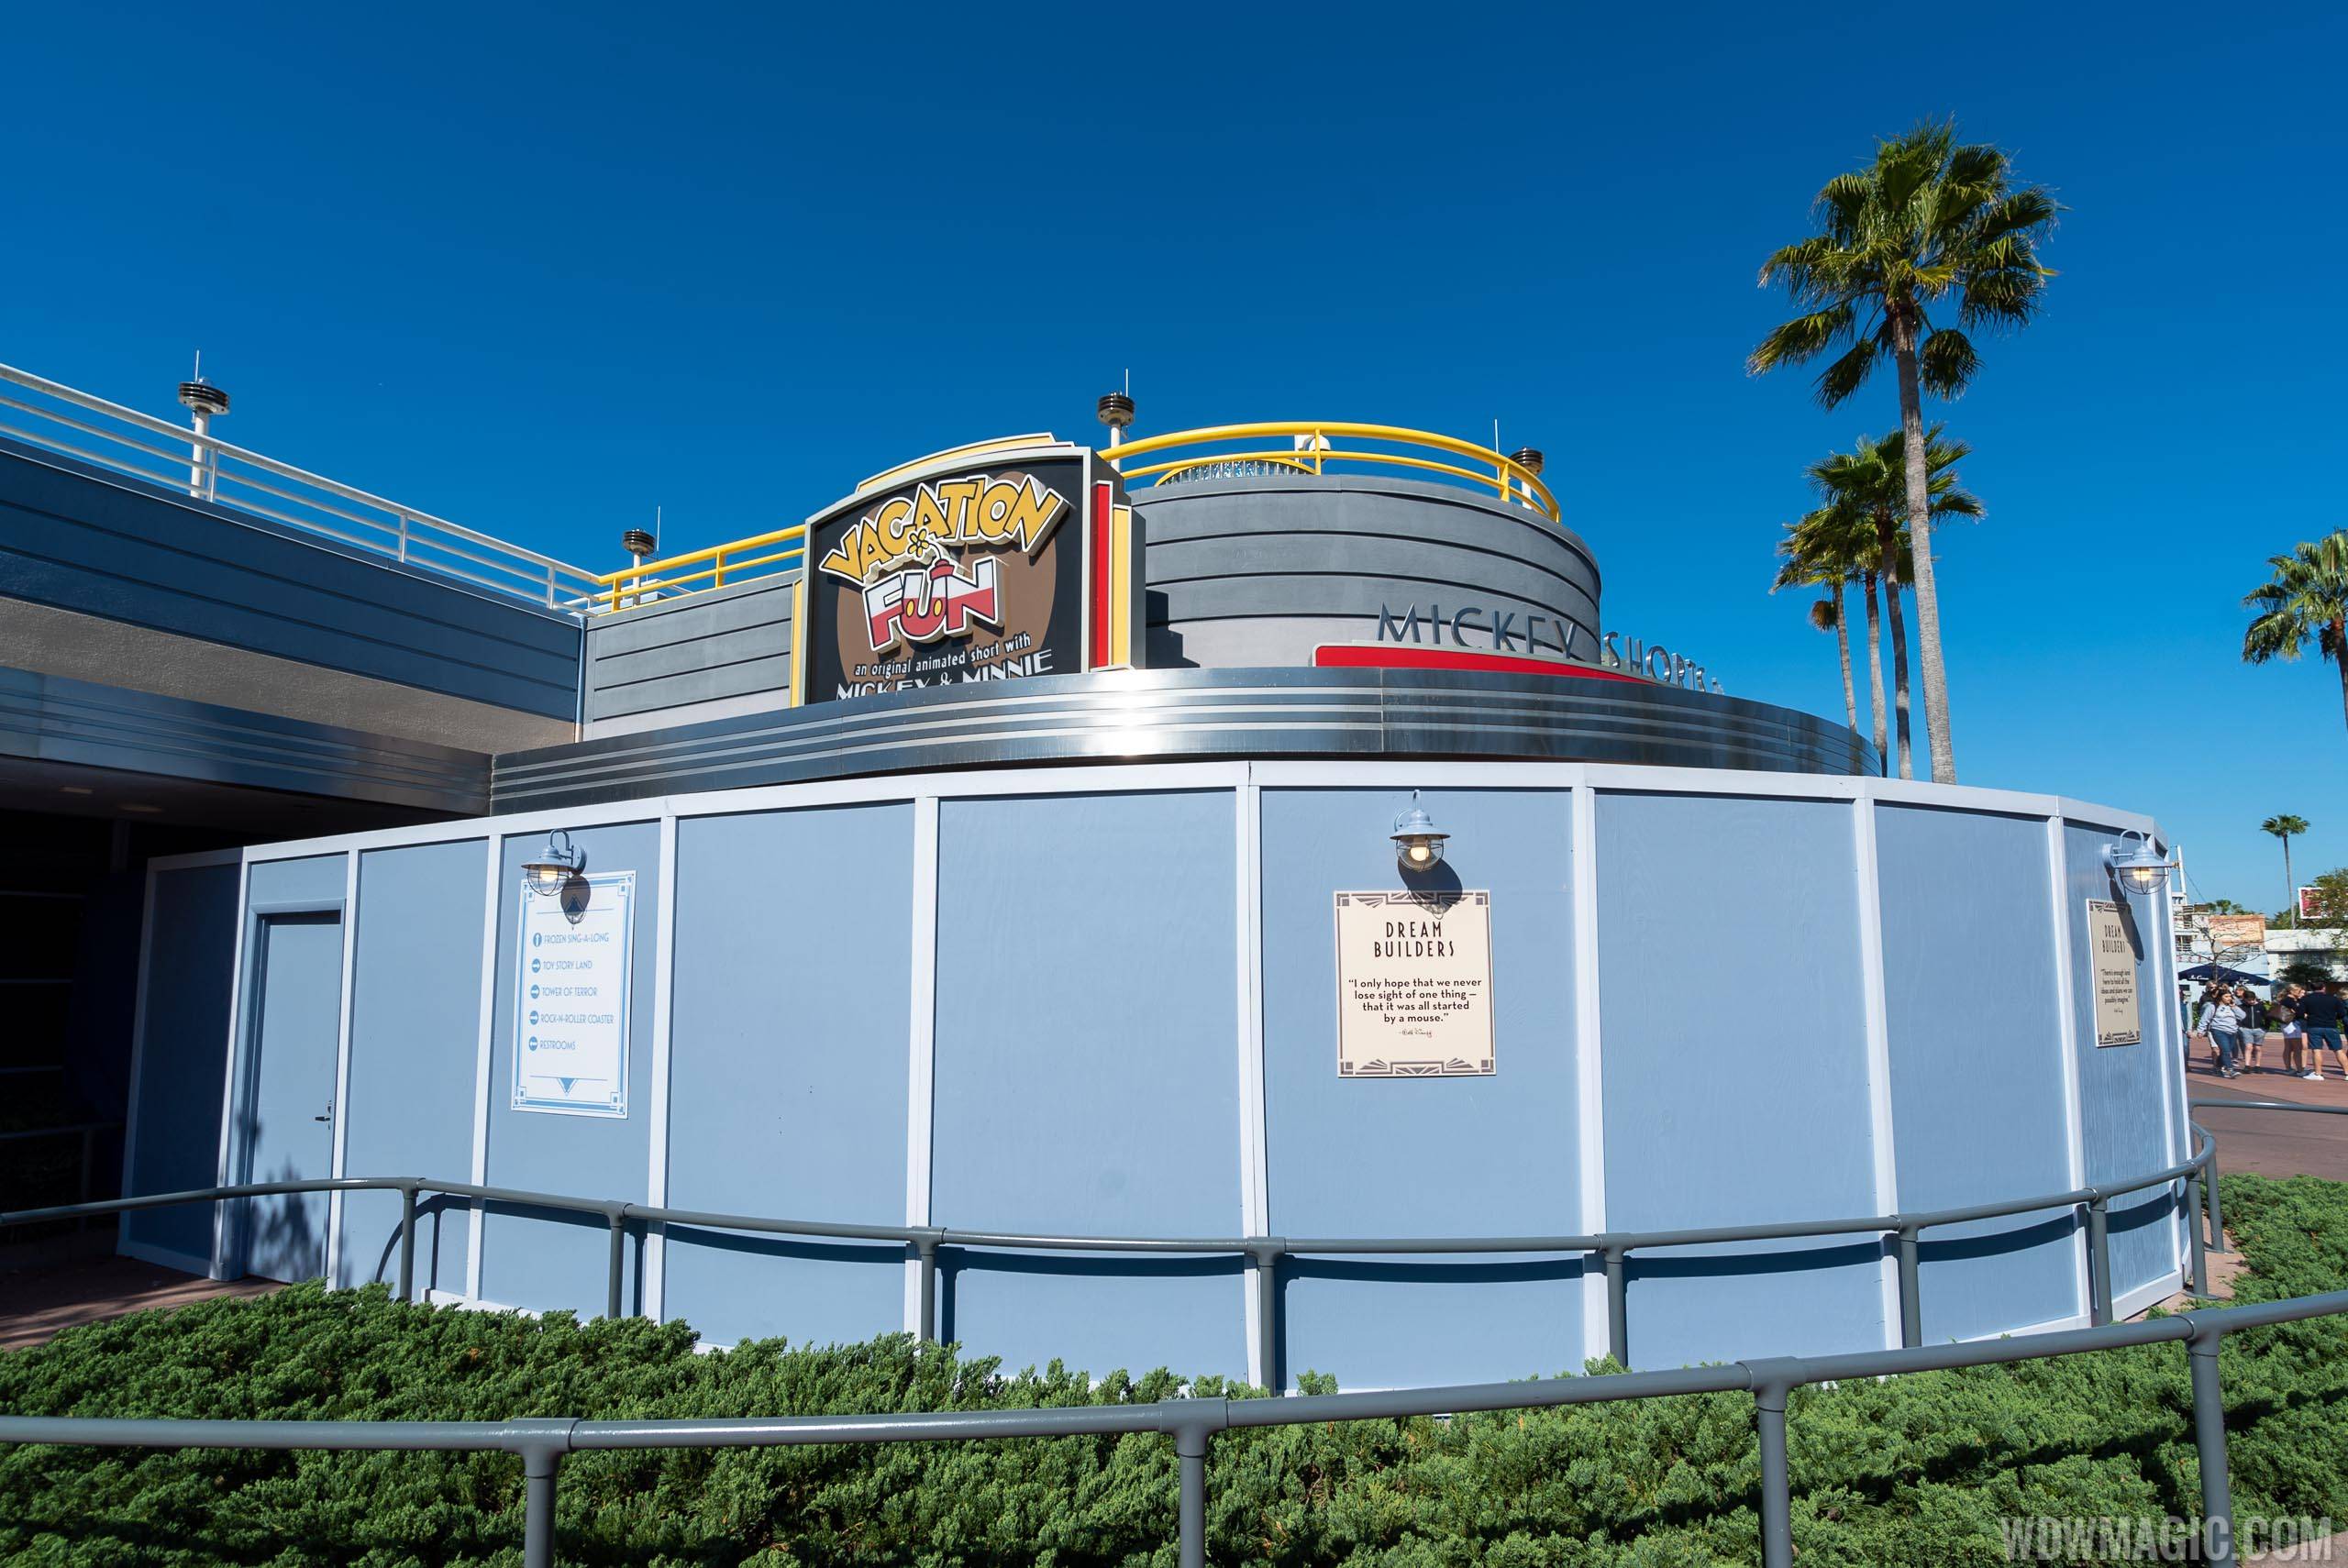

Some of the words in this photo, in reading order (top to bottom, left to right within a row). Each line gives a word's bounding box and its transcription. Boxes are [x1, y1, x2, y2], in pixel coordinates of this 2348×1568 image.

[819, 474, 1064, 583] VACATION
[862, 555, 998, 651] FUN
[1378, 601, 1579, 659] MICKEY
[1603, 631, 1706, 692] SHORTS
[855, 664, 867, 676] an
[871, 659, 911, 679] original
[915, 653, 966, 671] animated
[970, 643, 1000, 661] short
[1004, 633, 1031, 652] with
[939, 671, 953, 686] &
[962, 648, 1053, 683] MINNIE
[1386, 921, 1442, 938] DREAM
[2104, 923, 2121, 938] DREAM
[544, 933, 567, 944] FROZEN
[1374, 940, 1454, 957] BUILDERS
[2102, 940, 2126, 954] BUILDERS
[543, 960, 554, 970] TOY
[556, 960, 573, 970] STORY
[575, 960, 593, 969] LAND
[1360, 978, 1381, 989] only
[1384, 978, 1410, 989] hope
[1412, 977, 1434, 988] that
[542, 987, 562, 997] TOWER
[563, 987, 572, 997] OF
[574, 987, 597, 997] TERROR
[1355, 990, 1375, 999] lose
[1378, 989, 1402, 1001] sight
[1405, 989, 1416, 999] of
[1441, 989, 1467, 1000] thing
[1363, 1001, 1383, 1011] that
[1386, 1001, 1393, 1010] it
[1418, 1000, 1430, 1010] all
[1433, 1000, 1469, 1010] started
[588, 1014, 614, 1024] COASTER
[1384, 1013, 1396, 1025] by
[539, 1040, 576, 1051] RESTROOMS
